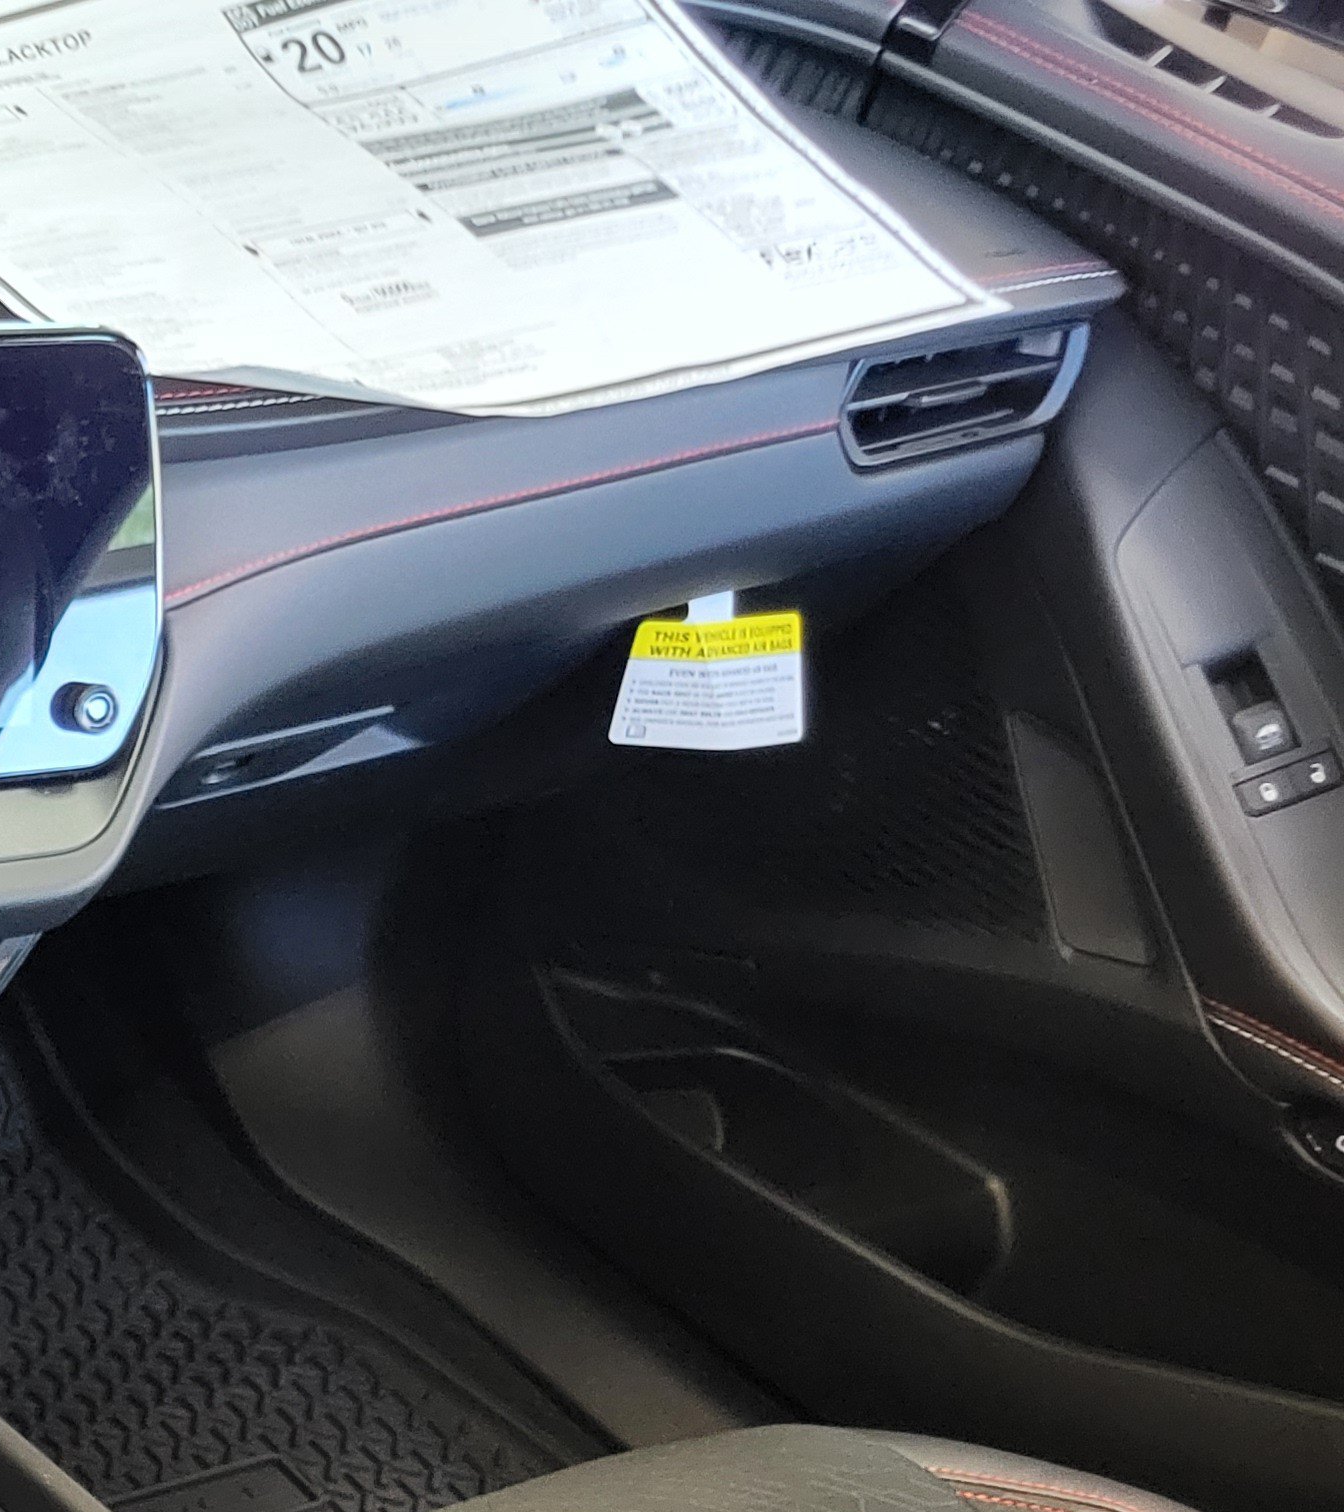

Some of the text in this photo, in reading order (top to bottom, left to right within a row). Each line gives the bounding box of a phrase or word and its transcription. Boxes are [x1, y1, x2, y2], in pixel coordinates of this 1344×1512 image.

[281, 31, 346, 73] 20
[654, 631, 690, 643] THIS
[649, 645, 691, 658] WITH
